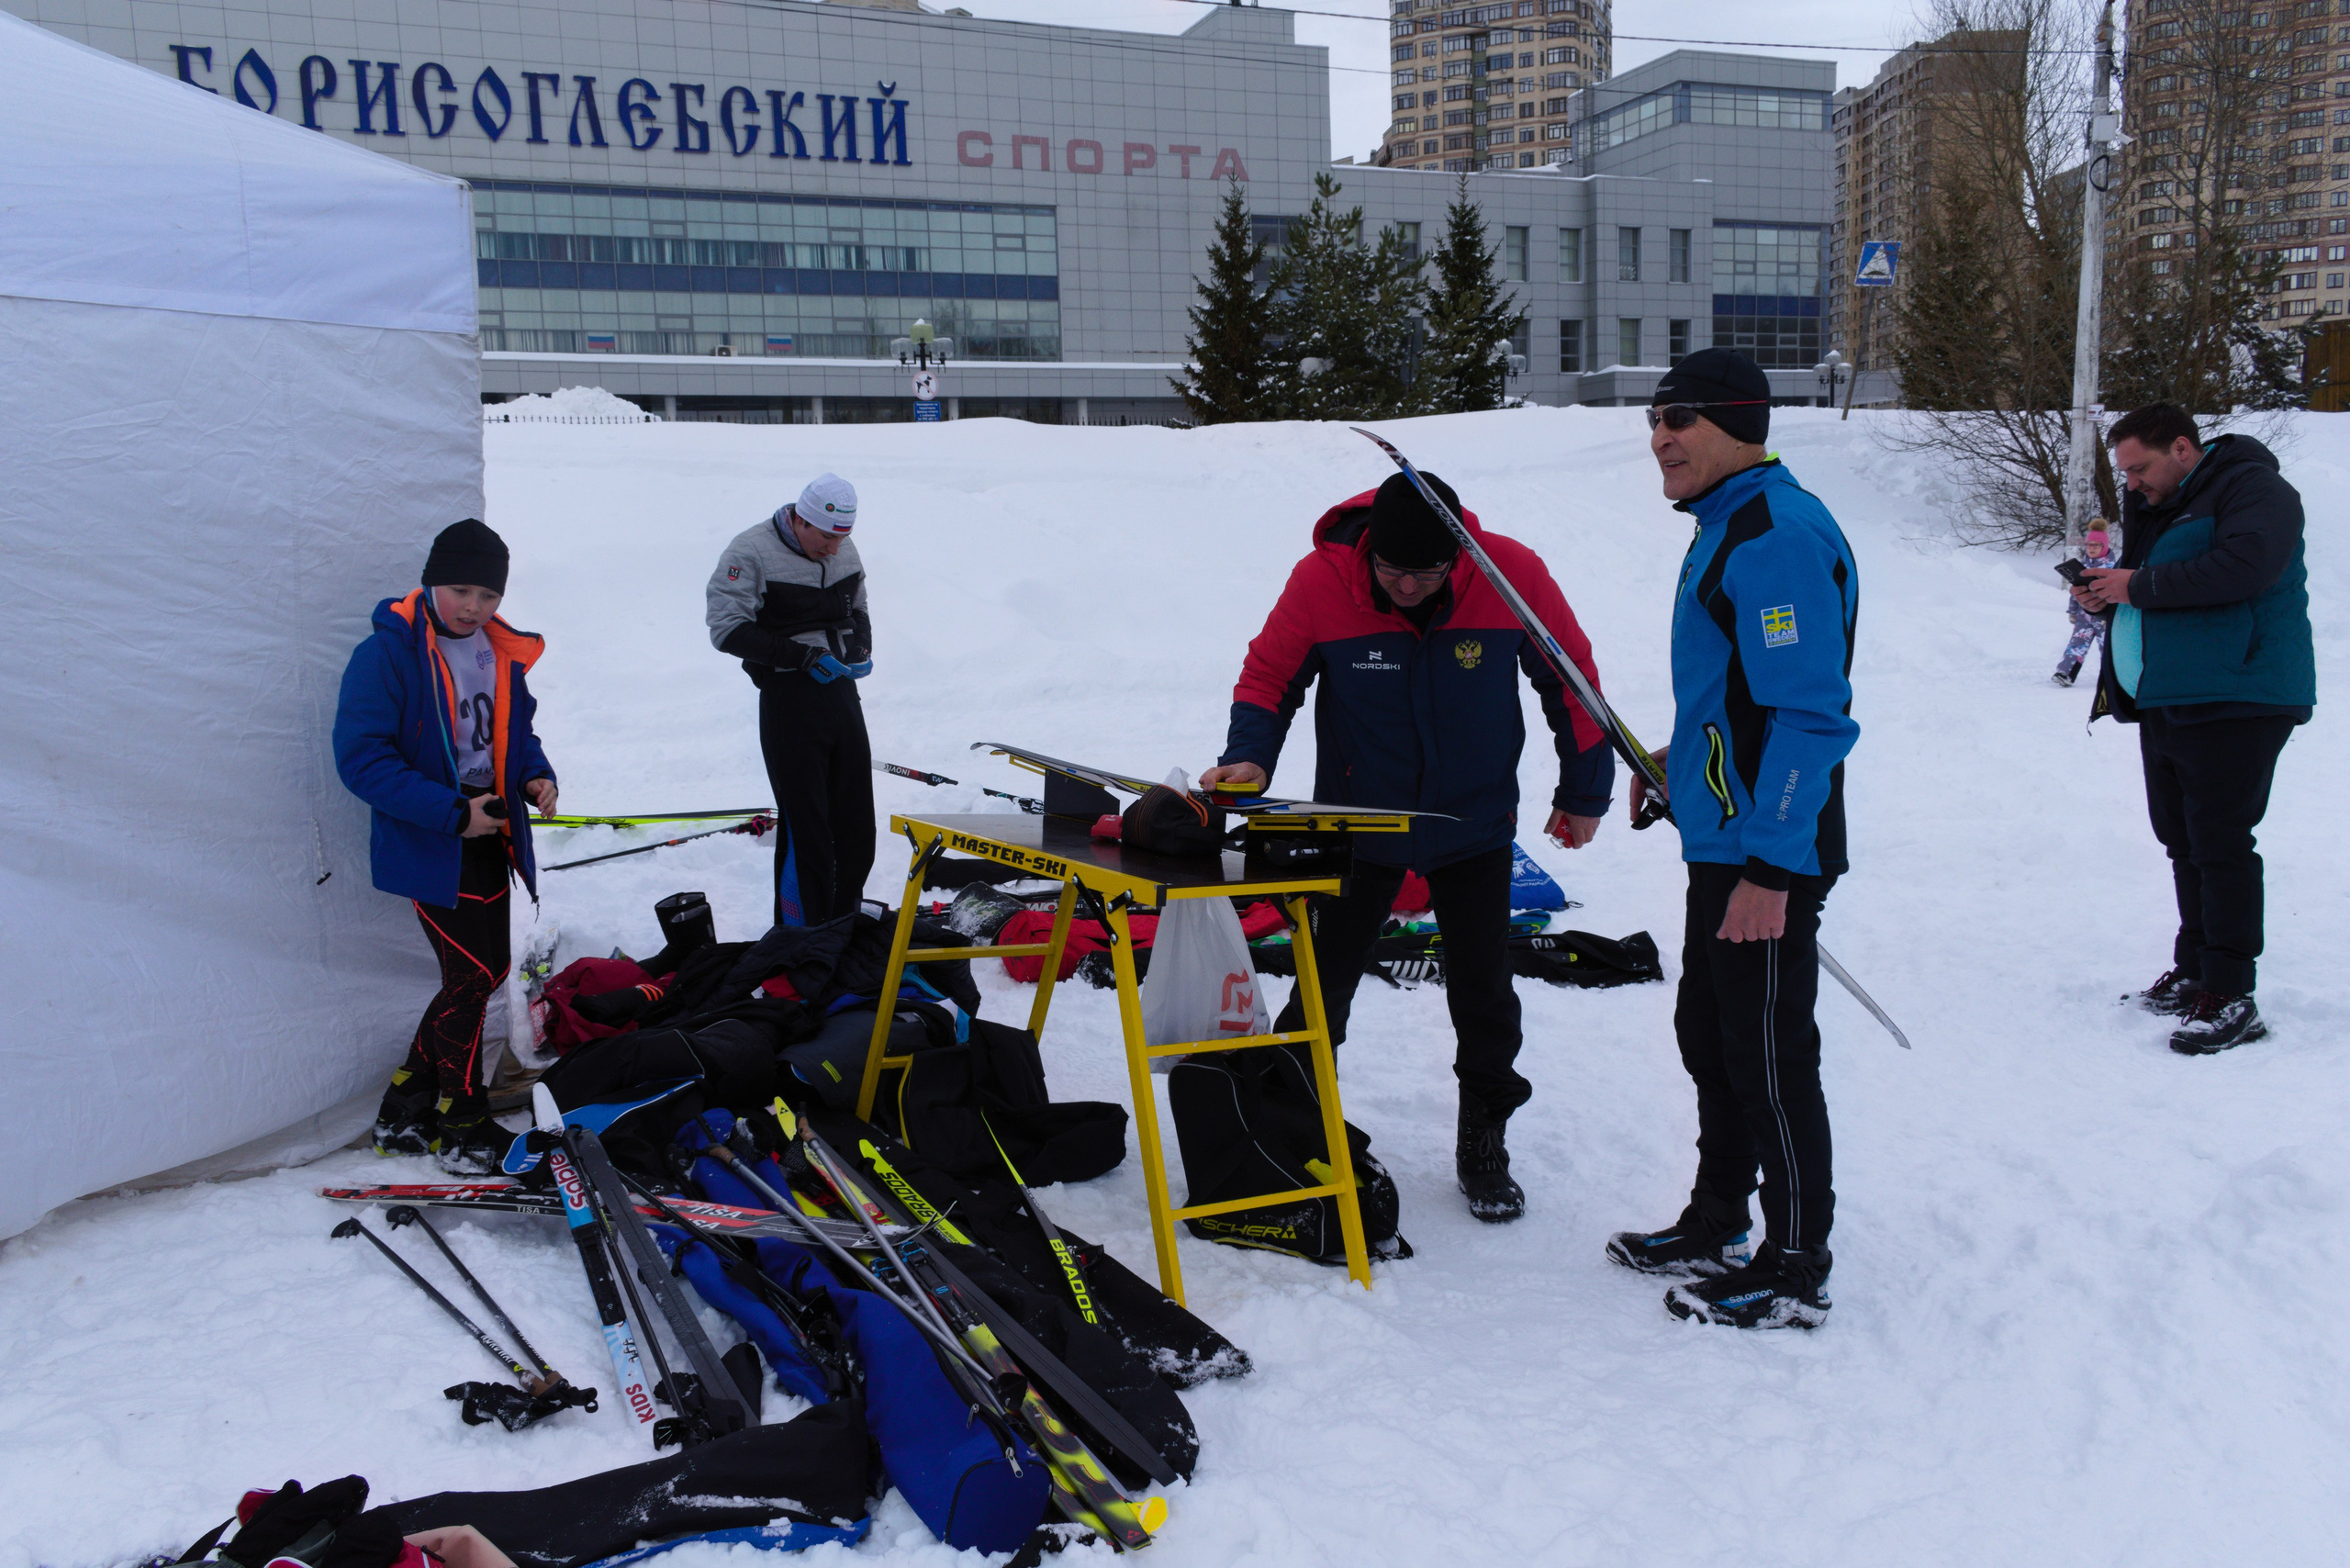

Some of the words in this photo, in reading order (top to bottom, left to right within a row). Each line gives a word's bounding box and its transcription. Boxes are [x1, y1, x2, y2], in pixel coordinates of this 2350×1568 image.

[957, 130, 1249, 181] СПОРТА
[1352, 662, 1401, 670] NORDSKI
[1784, 768, 1800, 793] TEAM
[1779, 795, 1792, 812] PRO
[951, 834, 1068, 878] MASTER-SKI
[550, 1152, 590, 1212] sable
[878, 1171, 938, 1220] BRADOS
[516, 1205, 540, 1215] TISA
[689, 1204, 743, 1219] TISA
[1196, 1216, 1283, 1238] ISCHER
[1049, 1239, 1099, 1325] BRADOS
[625, 1383, 656, 1425] KIDS
